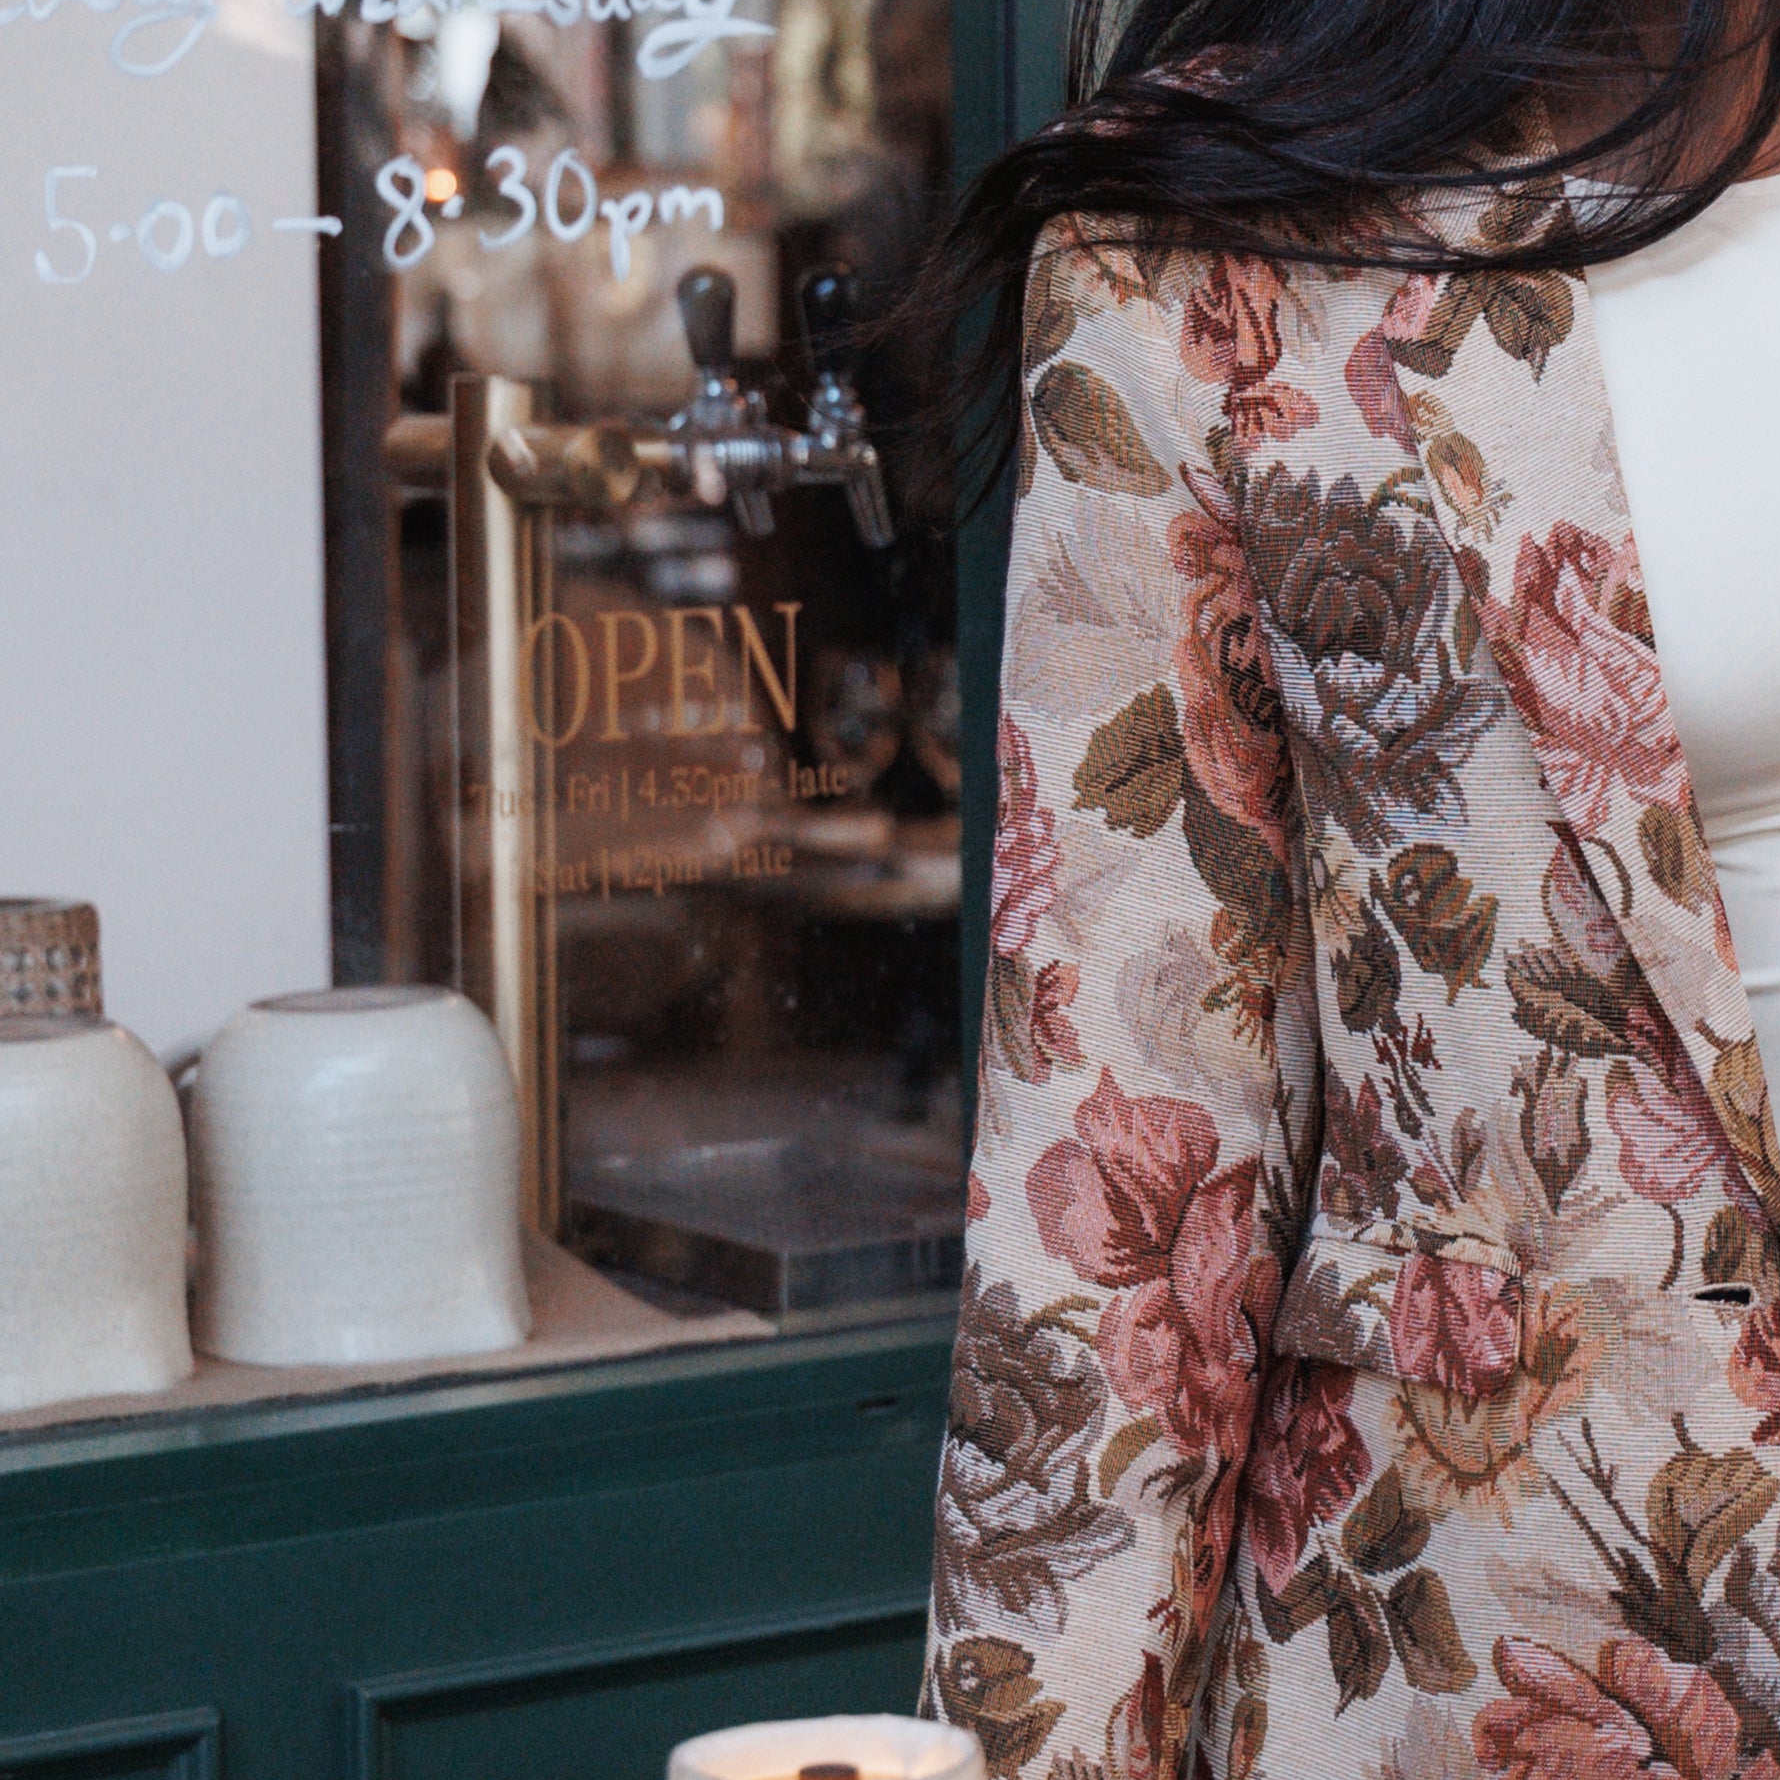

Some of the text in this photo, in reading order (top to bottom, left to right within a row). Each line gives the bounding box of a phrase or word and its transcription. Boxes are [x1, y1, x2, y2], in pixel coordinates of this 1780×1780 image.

[518, 601, 803, 748] OPEN
[567, 772, 613, 815] Fri
[788, 759, 850, 799] late
[731, 843, 793, 878] late
